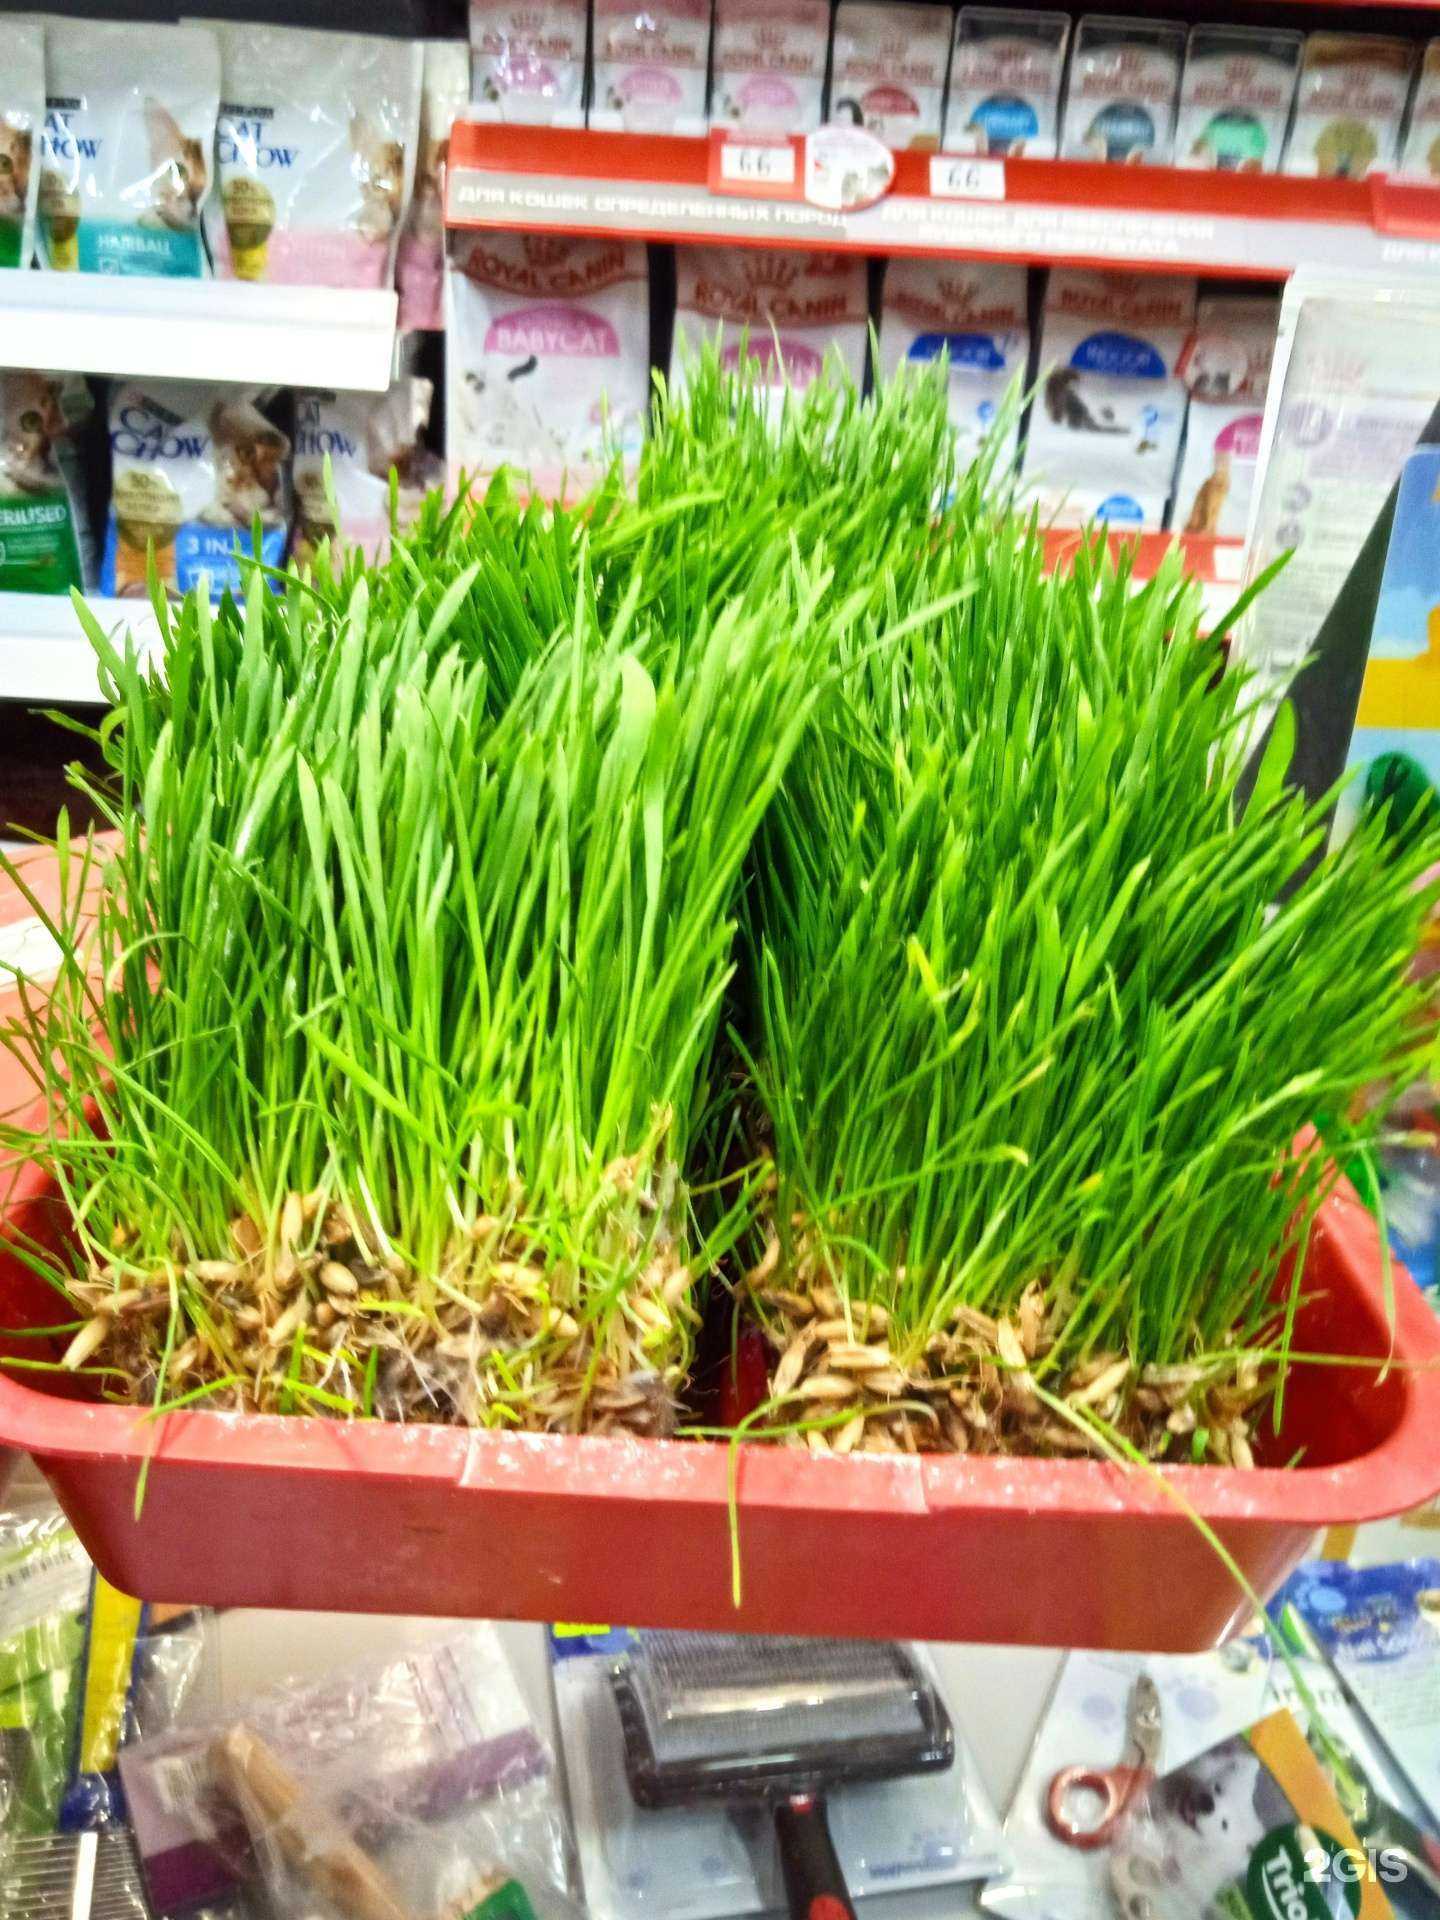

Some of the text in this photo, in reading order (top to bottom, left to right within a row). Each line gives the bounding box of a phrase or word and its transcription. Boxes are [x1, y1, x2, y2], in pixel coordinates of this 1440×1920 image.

[40, 135, 103, 159] HOW
[458, 186, 505, 204] ДЛЯ
[509, 188, 589, 211] КОШЕК
[468, 246, 538, 288] ROYAL
[497, 328, 606, 353] BABYCAT
[295, 431, 356, 458] HOW
[1266, 1844, 1321, 1920] Trio
